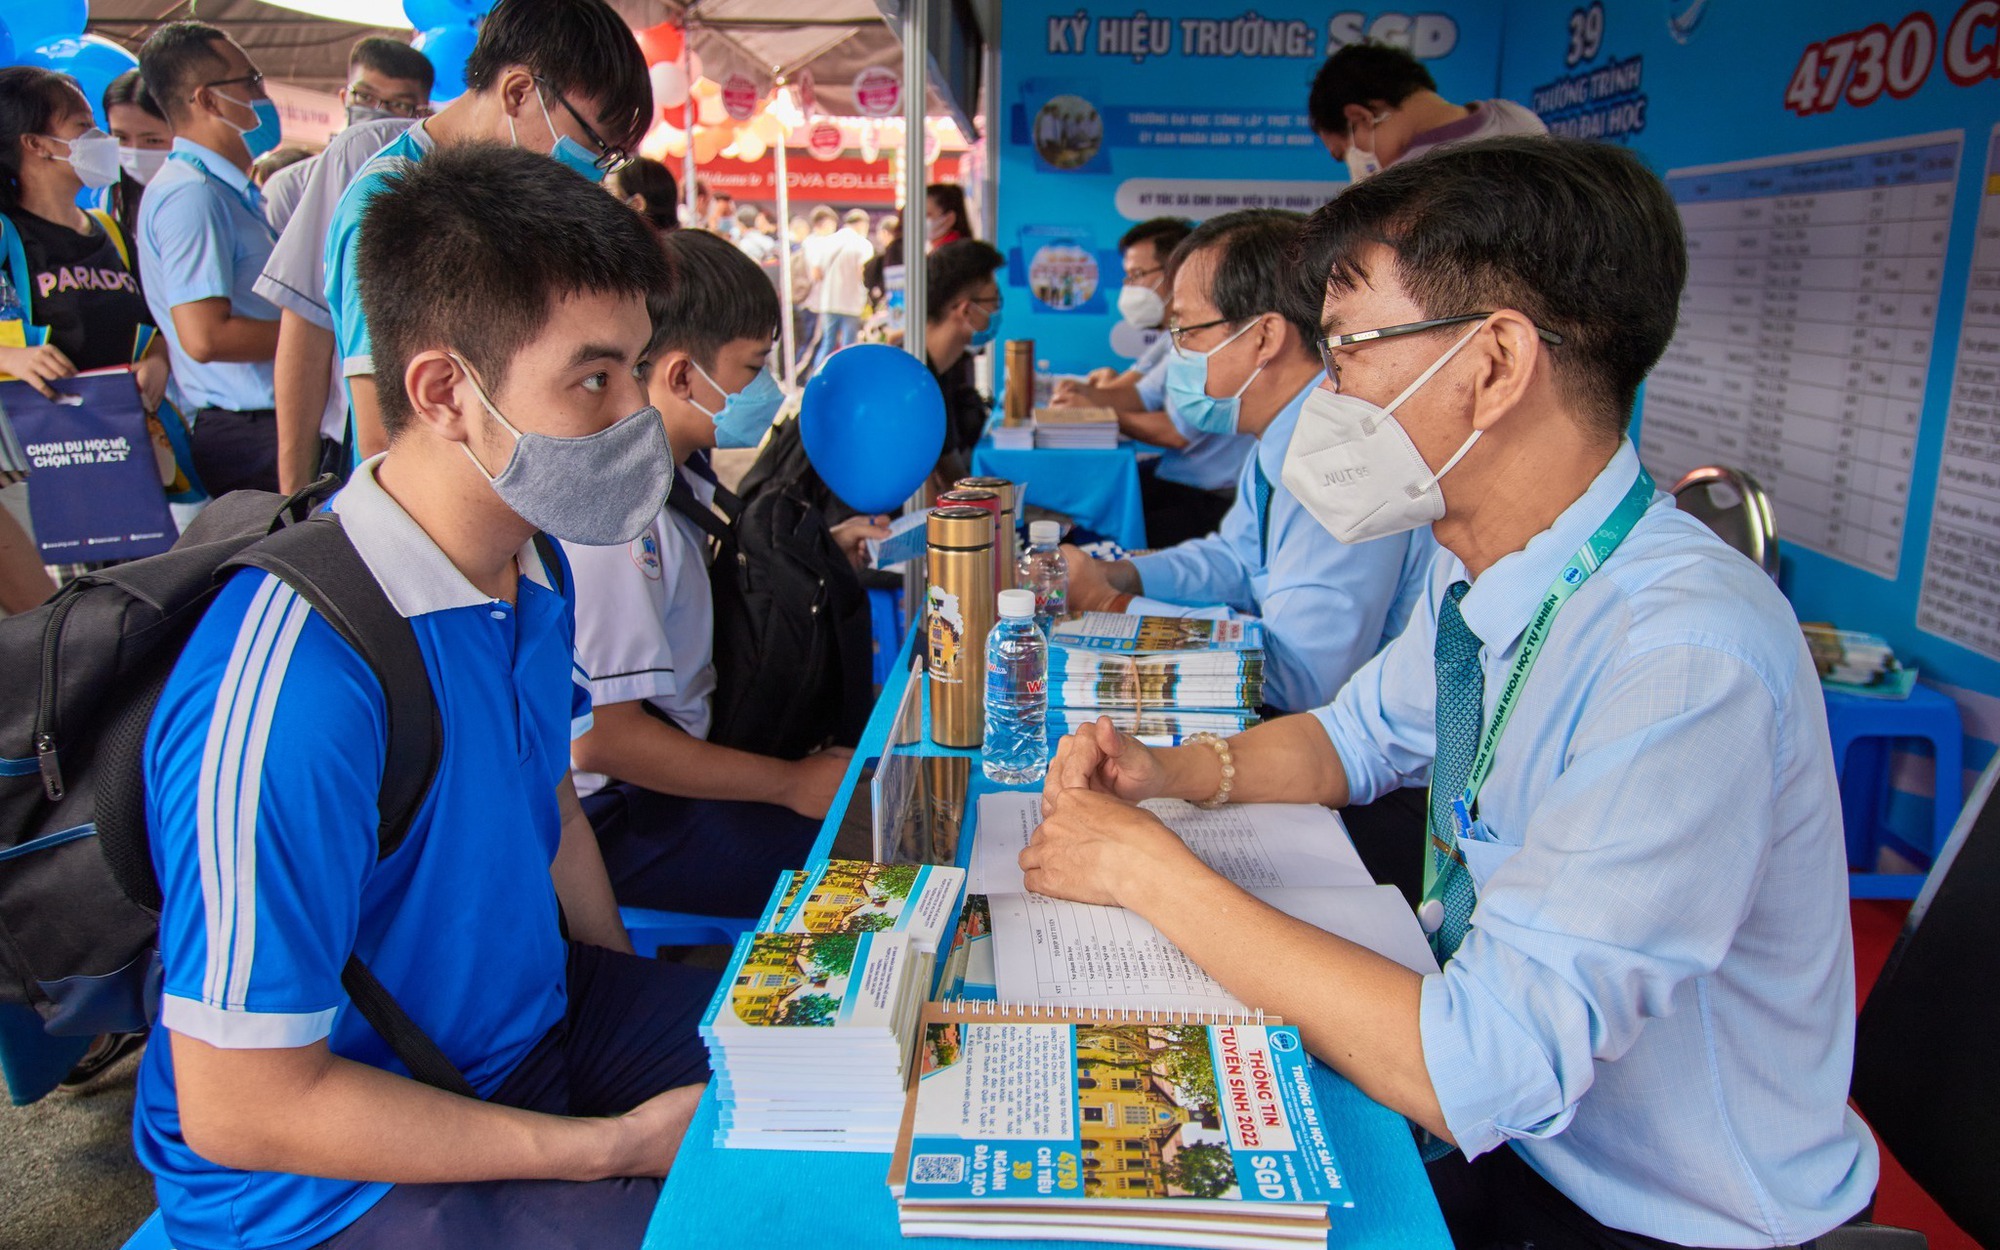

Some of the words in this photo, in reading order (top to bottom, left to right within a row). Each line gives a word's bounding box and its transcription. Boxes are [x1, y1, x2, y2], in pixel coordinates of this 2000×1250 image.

[1047, 9, 1088, 54] KÝ
[1098, 11, 1171, 63] HIỆU
[1181, 11, 1315, 57] TRƯỜNG:
[1567, 3, 1603, 65] 39
[1785, 12, 1937, 115] 4730
[1944, 0, 2000, 86] C
[826, 172, 897, 189] COLLE
[26, 442, 64, 457] CHỌN
[65, 441, 83, 453] DU
[84, 439, 110, 453] HỌC
[34, 453, 71, 468] CHỌN
[71, 451, 94, 464] THI
[1473, 751, 1487, 782] KHOA
[1484, 736, 1493, 751] SƯ
[1490, 703, 1506, 737] PHẠM
[1502, 673, 1521, 706] KHOA
[1517, 647, 1533, 672] HỌC
[1527, 632, 1539, 653] TỰ
[1534, 594, 1559, 631] NHIÊN
[1222, 1028, 1240, 1075] TUYỂN
[1277, 1033, 1290, 1049] SGU
[1230, 1079, 1247, 1111] SINH
[1250, 1050, 1272, 1099] THÔNG
[1262, 1104, 1278, 1126] TIN
[1293, 1066, 1312, 1106] TRƯỜNG
[1303, 1107, 1318, 1125] ĐẠI
[1238, 1116, 1258, 1146] 2022
[1310, 1127, 1326, 1147] HỌC
[973, 1145, 990, 1170] ĐÀO
[1037, 1147, 1056, 1167] CHỈ
[1317, 1149, 1333, 1165] SÀI
[993, 1150, 1008, 1190] NGÀNH
[1013, 1161, 1032, 1179] 39
[1037, 1169, 1054, 1194] TIÊU
[1058, 1152, 1077, 1189] 4730
[1252, 1156, 1284, 1199] SGD
[1324, 1167, 1341, 1189] GÒN
[970, 1172, 986, 1196] TẠO
